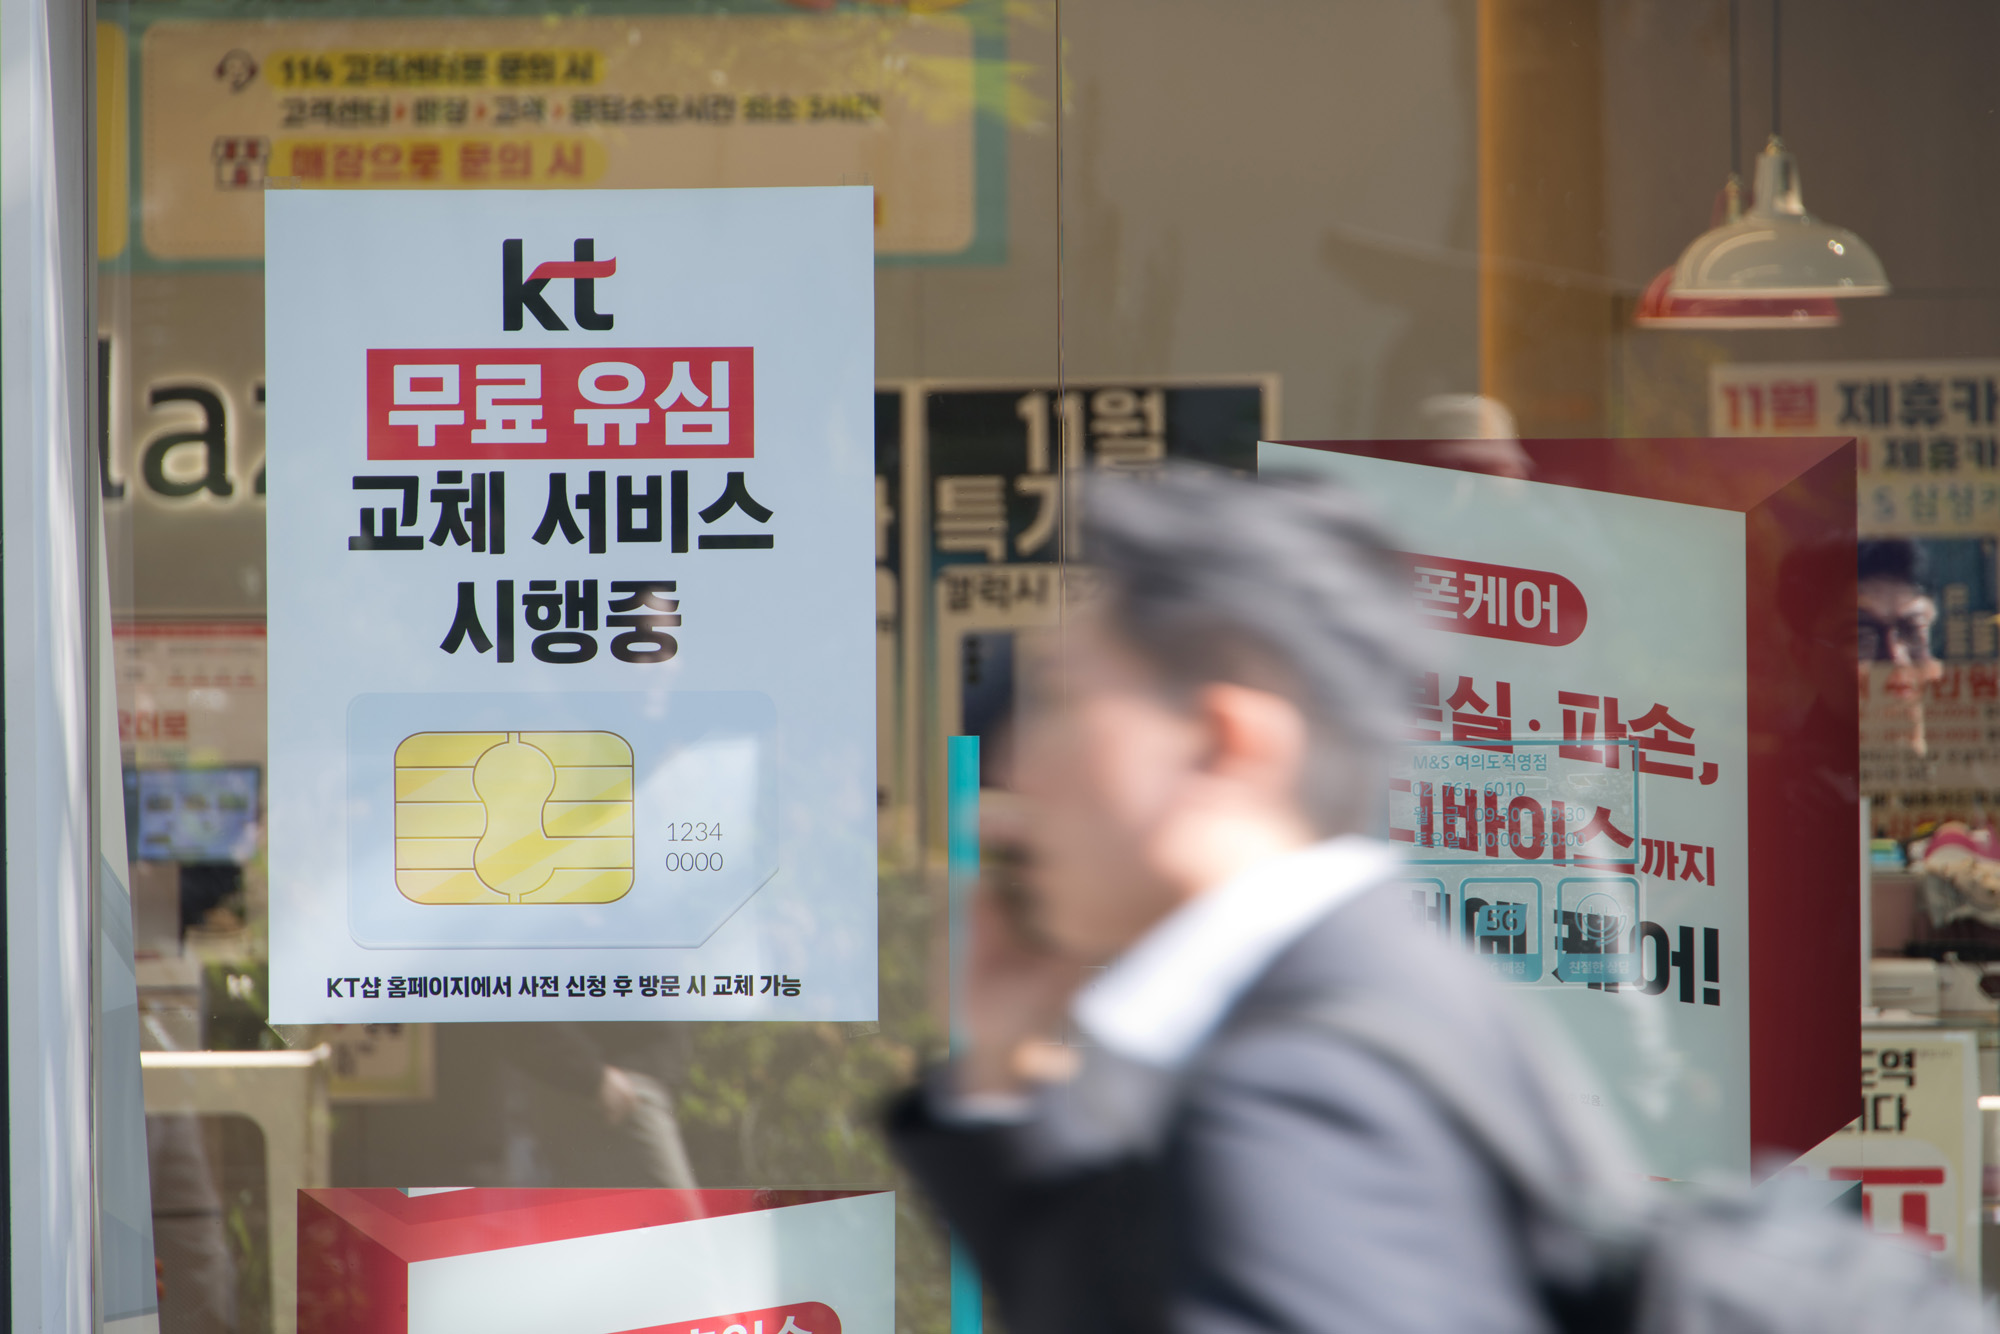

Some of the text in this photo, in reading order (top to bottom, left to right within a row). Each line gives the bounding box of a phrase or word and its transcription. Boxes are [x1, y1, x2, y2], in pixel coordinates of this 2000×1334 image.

[502, 238, 617, 331] kt
[388, 360, 730, 447] 무료 유심
[348, 470, 505, 555] 교체
[532, 470, 774, 554] 서비스
[439, 578, 682, 664] 시행중
[1413, 753, 1548, 772] M&S 여의도직영점
[1484, 782, 1526, 797] 6010
[667, 822, 723, 841] 1234
[1414, 831, 1460, 849] 토요일
[665, 852, 723, 871] 0000
[1486, 909, 1519, 931] 5G
[1569, 961, 1629, 975] 친절한 상담
[326, 974, 802, 999] KT샵 홈페이지에서 사전 신청 후 방문 시 교체 가능
